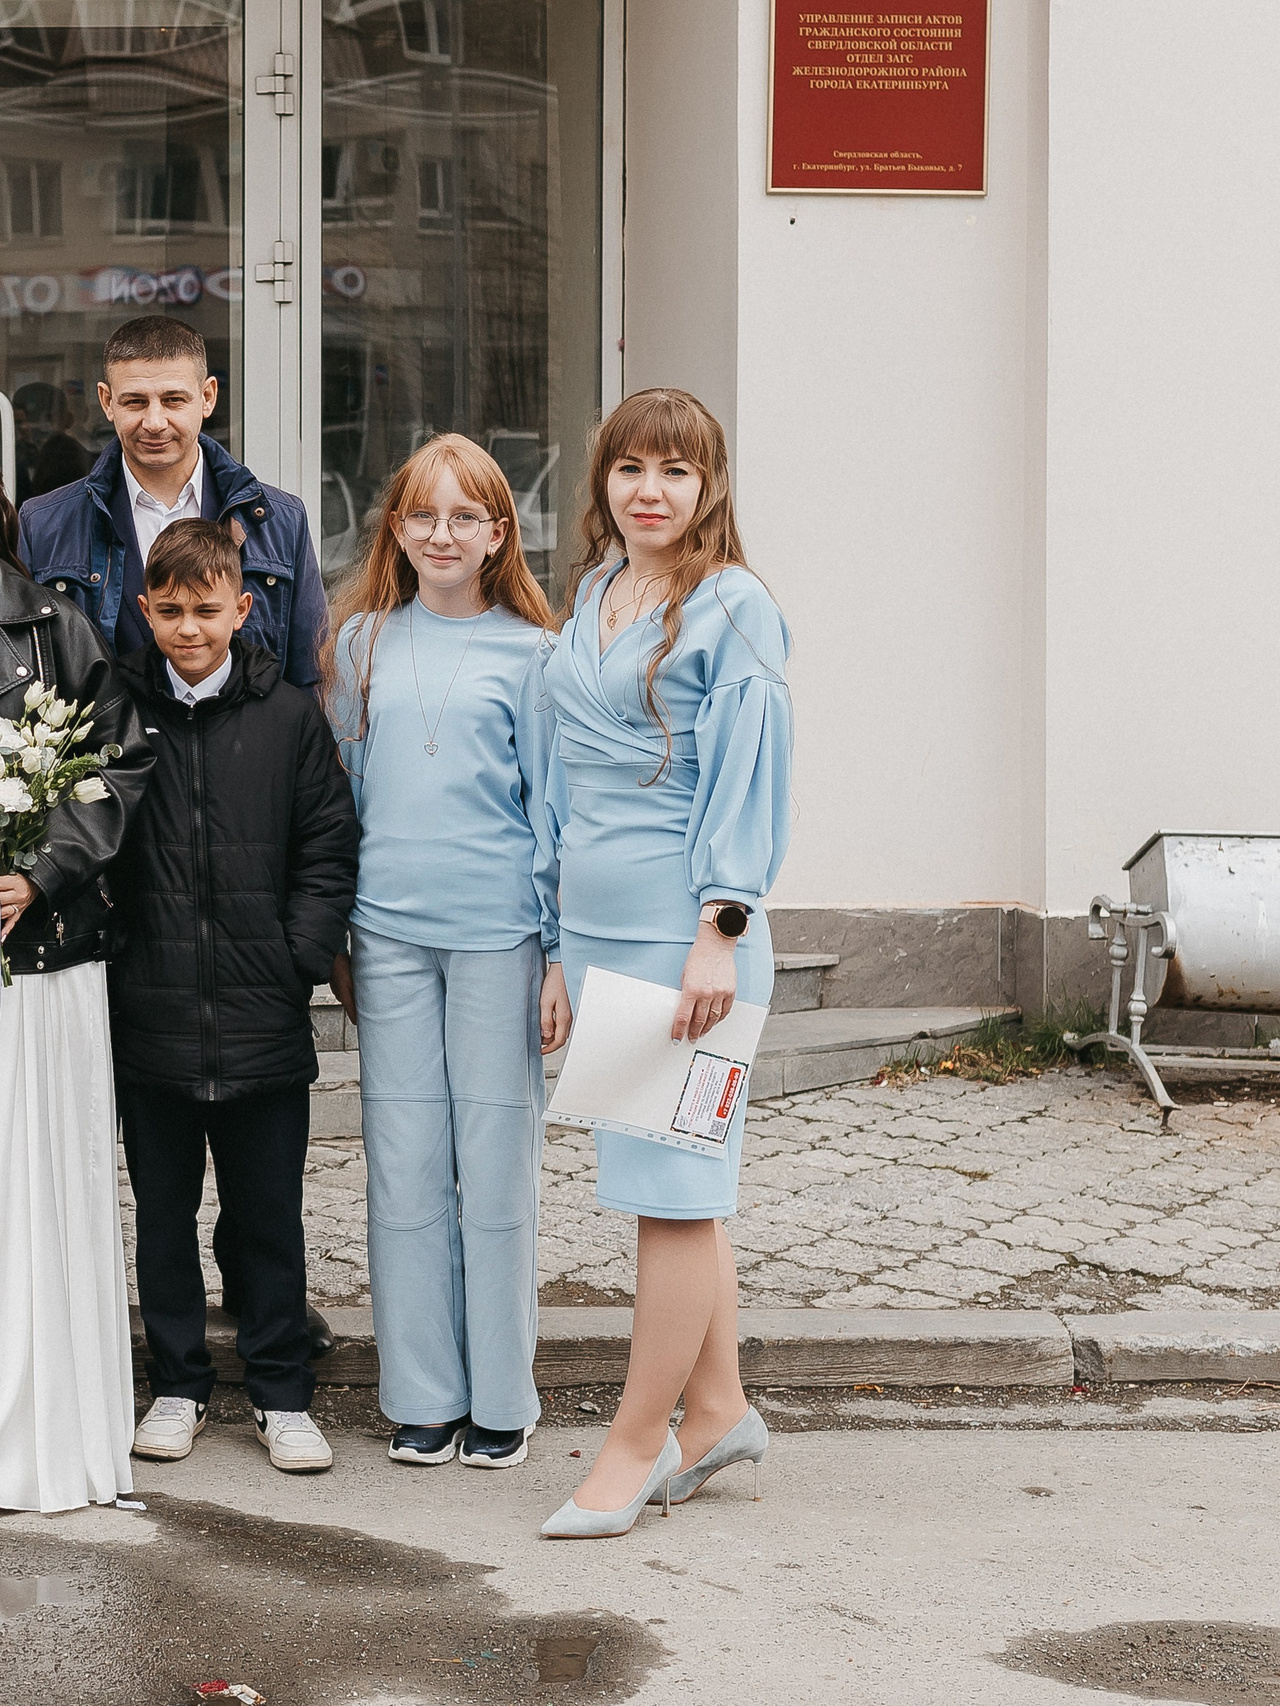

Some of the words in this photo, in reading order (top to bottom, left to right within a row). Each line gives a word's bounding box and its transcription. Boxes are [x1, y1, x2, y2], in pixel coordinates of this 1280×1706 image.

[799, 13, 874, 24] УПРАВЛЕНИЕ
[876, 14, 923, 24] ЗАПИСИ
[925, 15, 963, 25] АКТОВ
[799, 26, 891, 38] ГРАЖДАНСКОГО
[893, 28, 962, 38] СОСТОЯНИЯ
[807, 38, 898, 51] СВЕРДЛОВСКОЙ
[900, 41, 953, 51] ОБЛАСТИ
[846, 53, 883, 64] ОТДЕЛ
[886, 54, 914, 64] ЗАГС
[792, 66, 919, 77] ЖЕЛЕЗНОДОРОЖНОГО
[921, 65, 968, 77] РАЙОНА
[809, 79, 853, 90] ГОРОДА
[856, 79, 949, 90] ЕКАТЕРИНБУРГА
